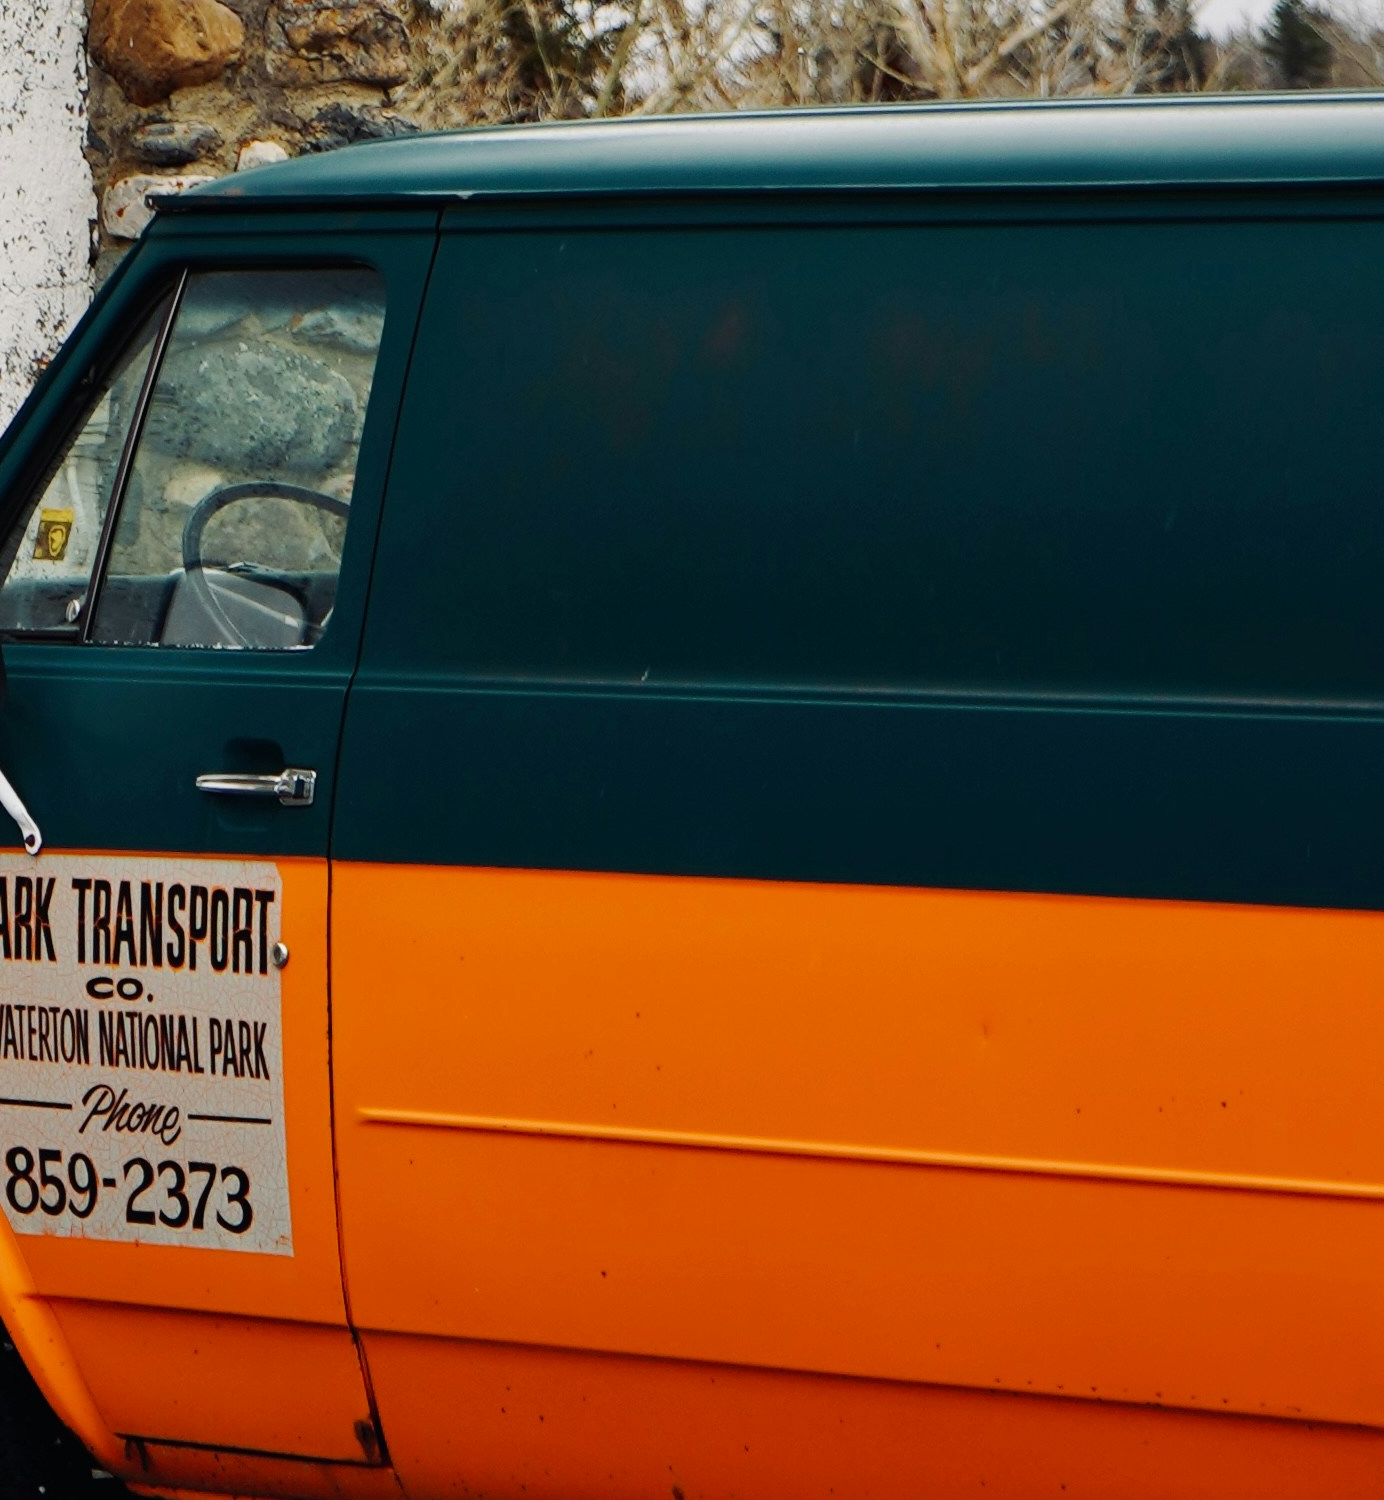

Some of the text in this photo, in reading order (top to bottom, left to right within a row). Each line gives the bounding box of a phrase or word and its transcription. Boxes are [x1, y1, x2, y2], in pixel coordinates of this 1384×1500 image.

[71, 877, 275, 975] TRANSPORT
[85, 976, 154, 1003] CO.
[98, 1010, 205, 1074] NATIONAL
[209, 1017, 270, 1081] PARK
[79, 1084, 182, 1145] Phone
[5, 1146, 253, 1233] 859-2373
